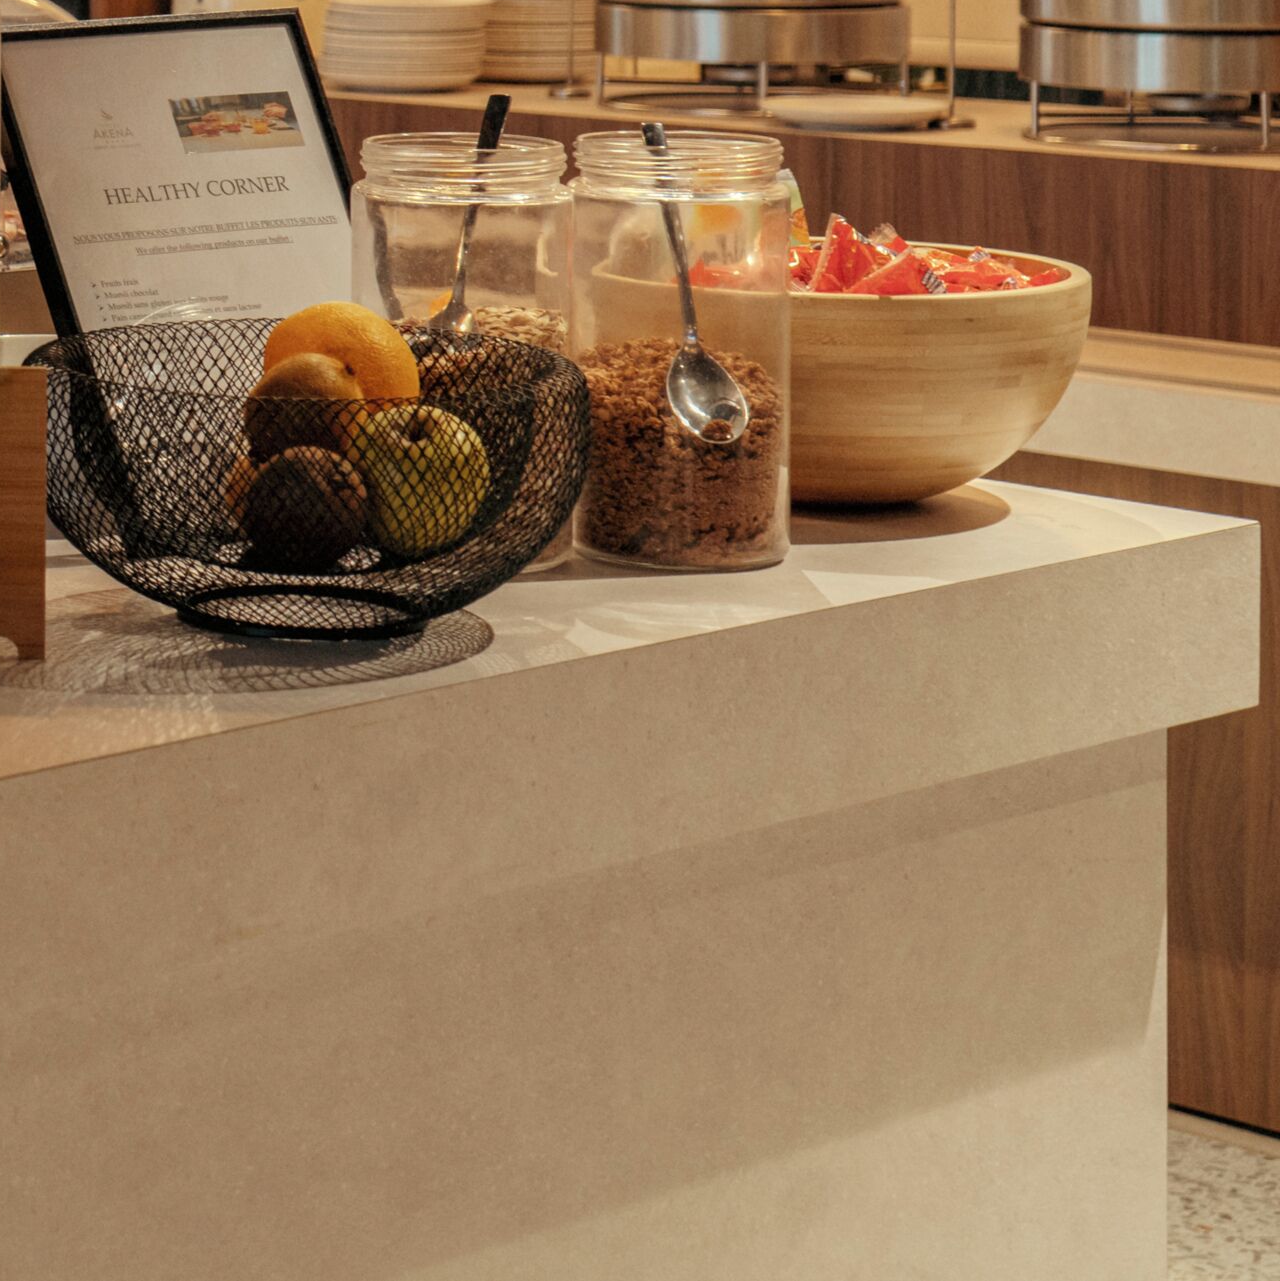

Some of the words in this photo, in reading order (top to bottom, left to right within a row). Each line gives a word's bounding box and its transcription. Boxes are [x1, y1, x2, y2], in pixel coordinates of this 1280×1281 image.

[103, 181, 201, 205] HEALTHY
[206, 175, 290, 197] CORNER
[73, 234, 96, 244] NOUS
[97, 232, 121, 242] VOUS
[121, 229, 169, 240] PROPOSONS
[170, 226, 187, 236] SUR
[188, 224, 214, 235] NOTRE
[216, 221, 244, 233] BUFFET
[246, 219, 260, 229] LES
[260, 218, 299, 228] PRODUITS
[136, 246, 149, 256] We
[150, 244, 165, 254] offer
[167, 243, 178, 253] the
[179, 240, 212, 252] following
[214, 238, 244, 250] products
[255, 237, 267, 246] our
[101, 279, 122, 289] Fruits
[129, 288, 159, 298] chocolat
